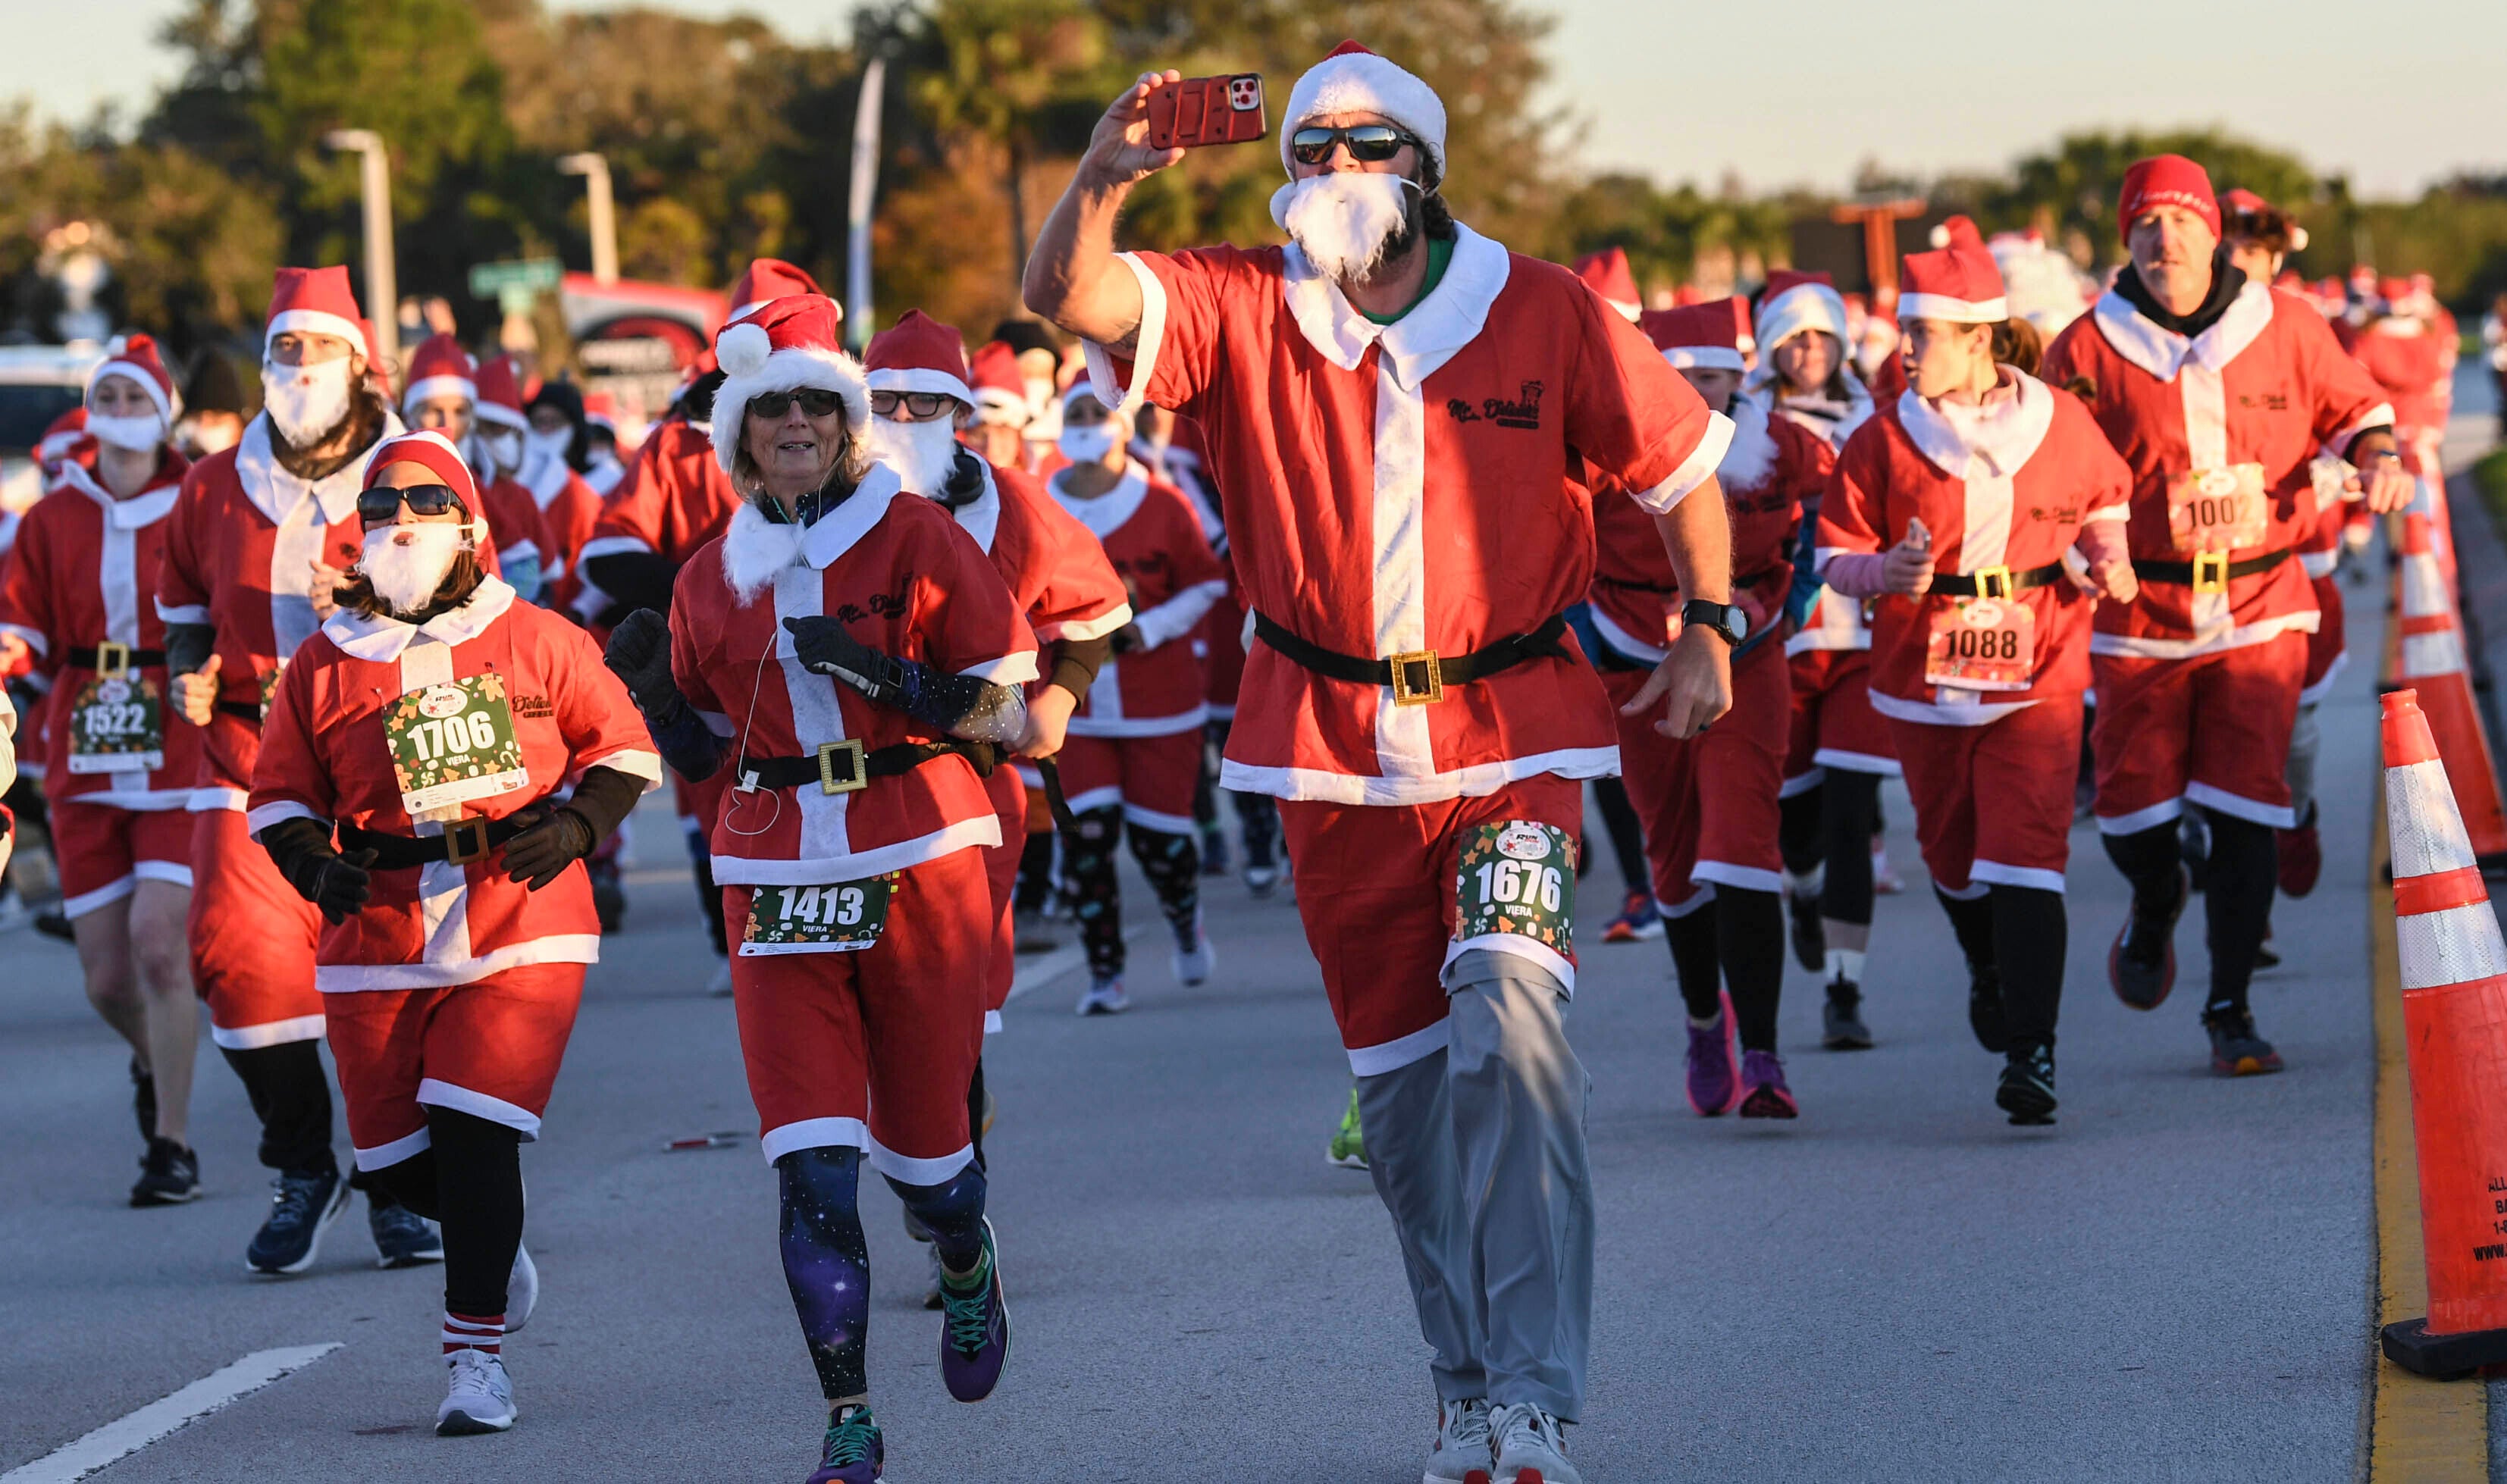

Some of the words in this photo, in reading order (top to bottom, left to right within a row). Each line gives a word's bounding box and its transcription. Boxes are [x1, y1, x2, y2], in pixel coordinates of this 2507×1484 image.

[2186, 494, 2255, 529] 1002
[1946, 630, 2017, 659] 1088
[83, 703, 146, 734] 1522
[406, 711, 496, 761] 1706
[445, 753, 471, 766] VIERA
[1475, 859, 1562, 913] 1676
[778, 886, 864, 925] 1413
[1505, 904, 1533, 917] VIERA
[802, 924, 828, 933] VIERA
